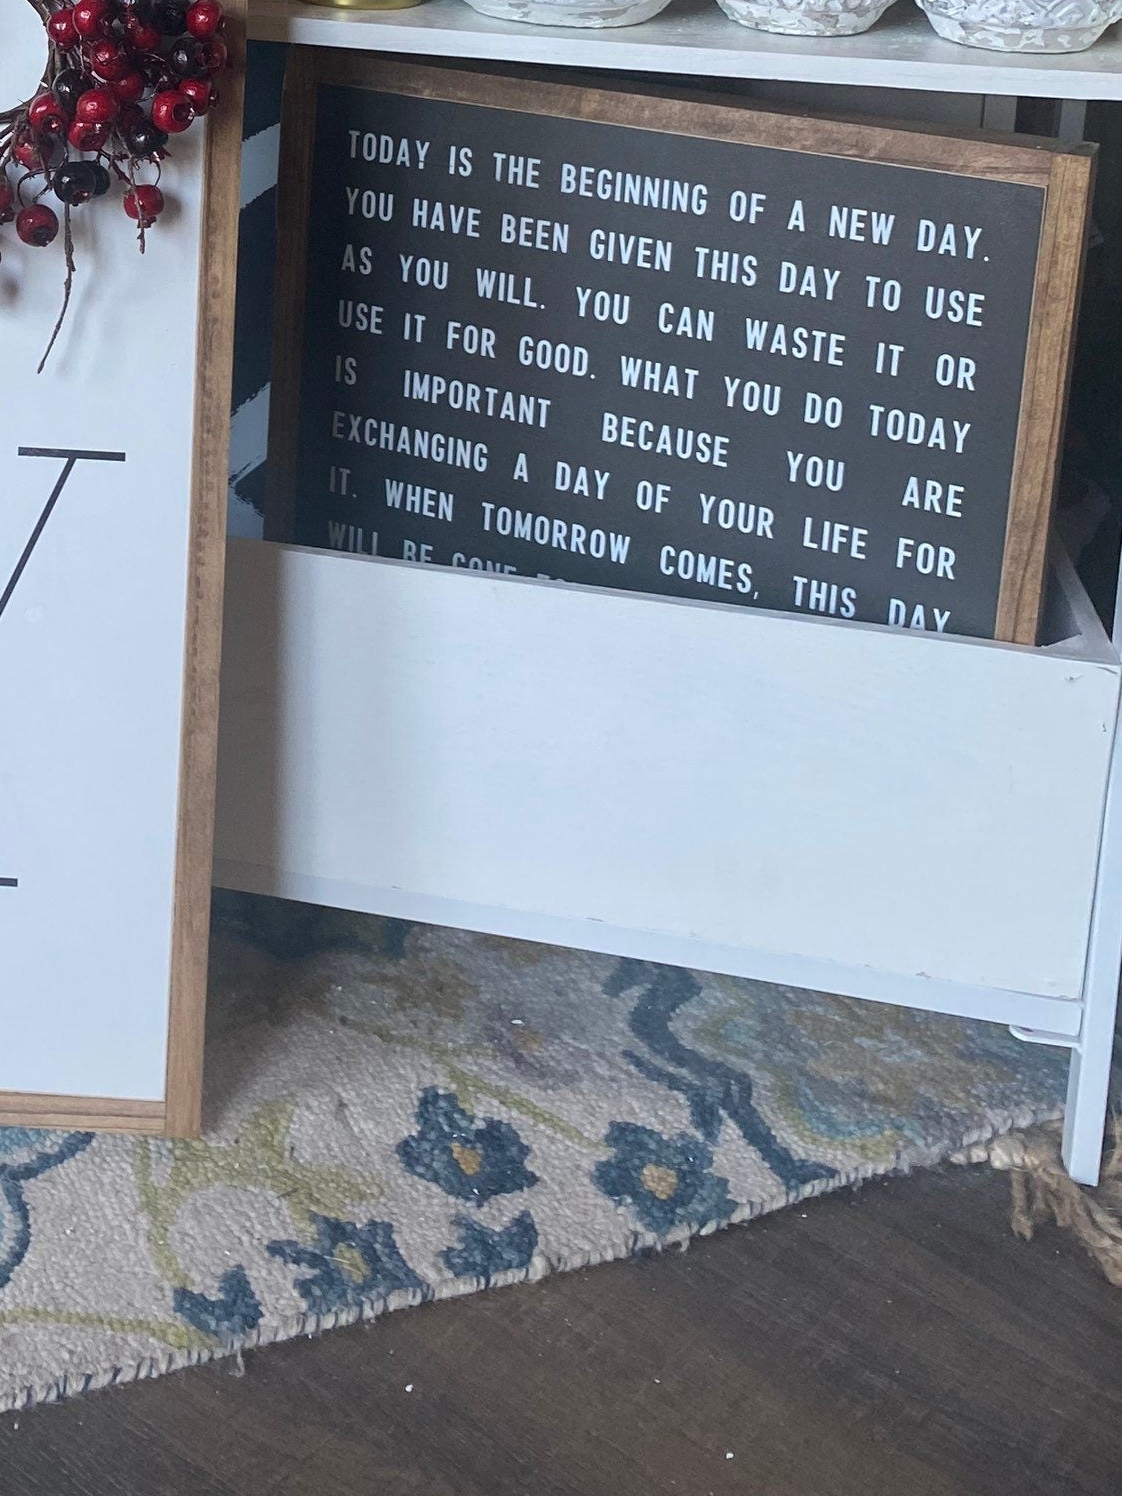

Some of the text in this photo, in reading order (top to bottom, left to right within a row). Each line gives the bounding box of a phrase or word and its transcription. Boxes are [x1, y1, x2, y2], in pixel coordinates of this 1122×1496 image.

[345, 186, 986, 327] YOU HAVE BEEN GIVEN THIS DAY TO USE
[348, 129, 990, 260] TODAY IS THE BEGINNING OF A NEW DAY.
[338, 299, 972, 454] USE IT FOR GOOD. WHAT YOU DO TODAY
[341, 243, 977, 392] AS YOU WILL. YOU CAN WASTE IT OR
[333, 410, 956, 581] EXCHANGING A DAY OF YOUR LIFE FOR
[335, 355, 965, 518] IS IMPORTANT BECAUSE YOU ARE
[384, 478, 454, 523] WHEN
[481, 501, 632, 568] TOMORROW
[659, 545, 759, 599] COMES,
[792, 575, 857, 617] THIS
[889, 599, 952, 631] DAY
